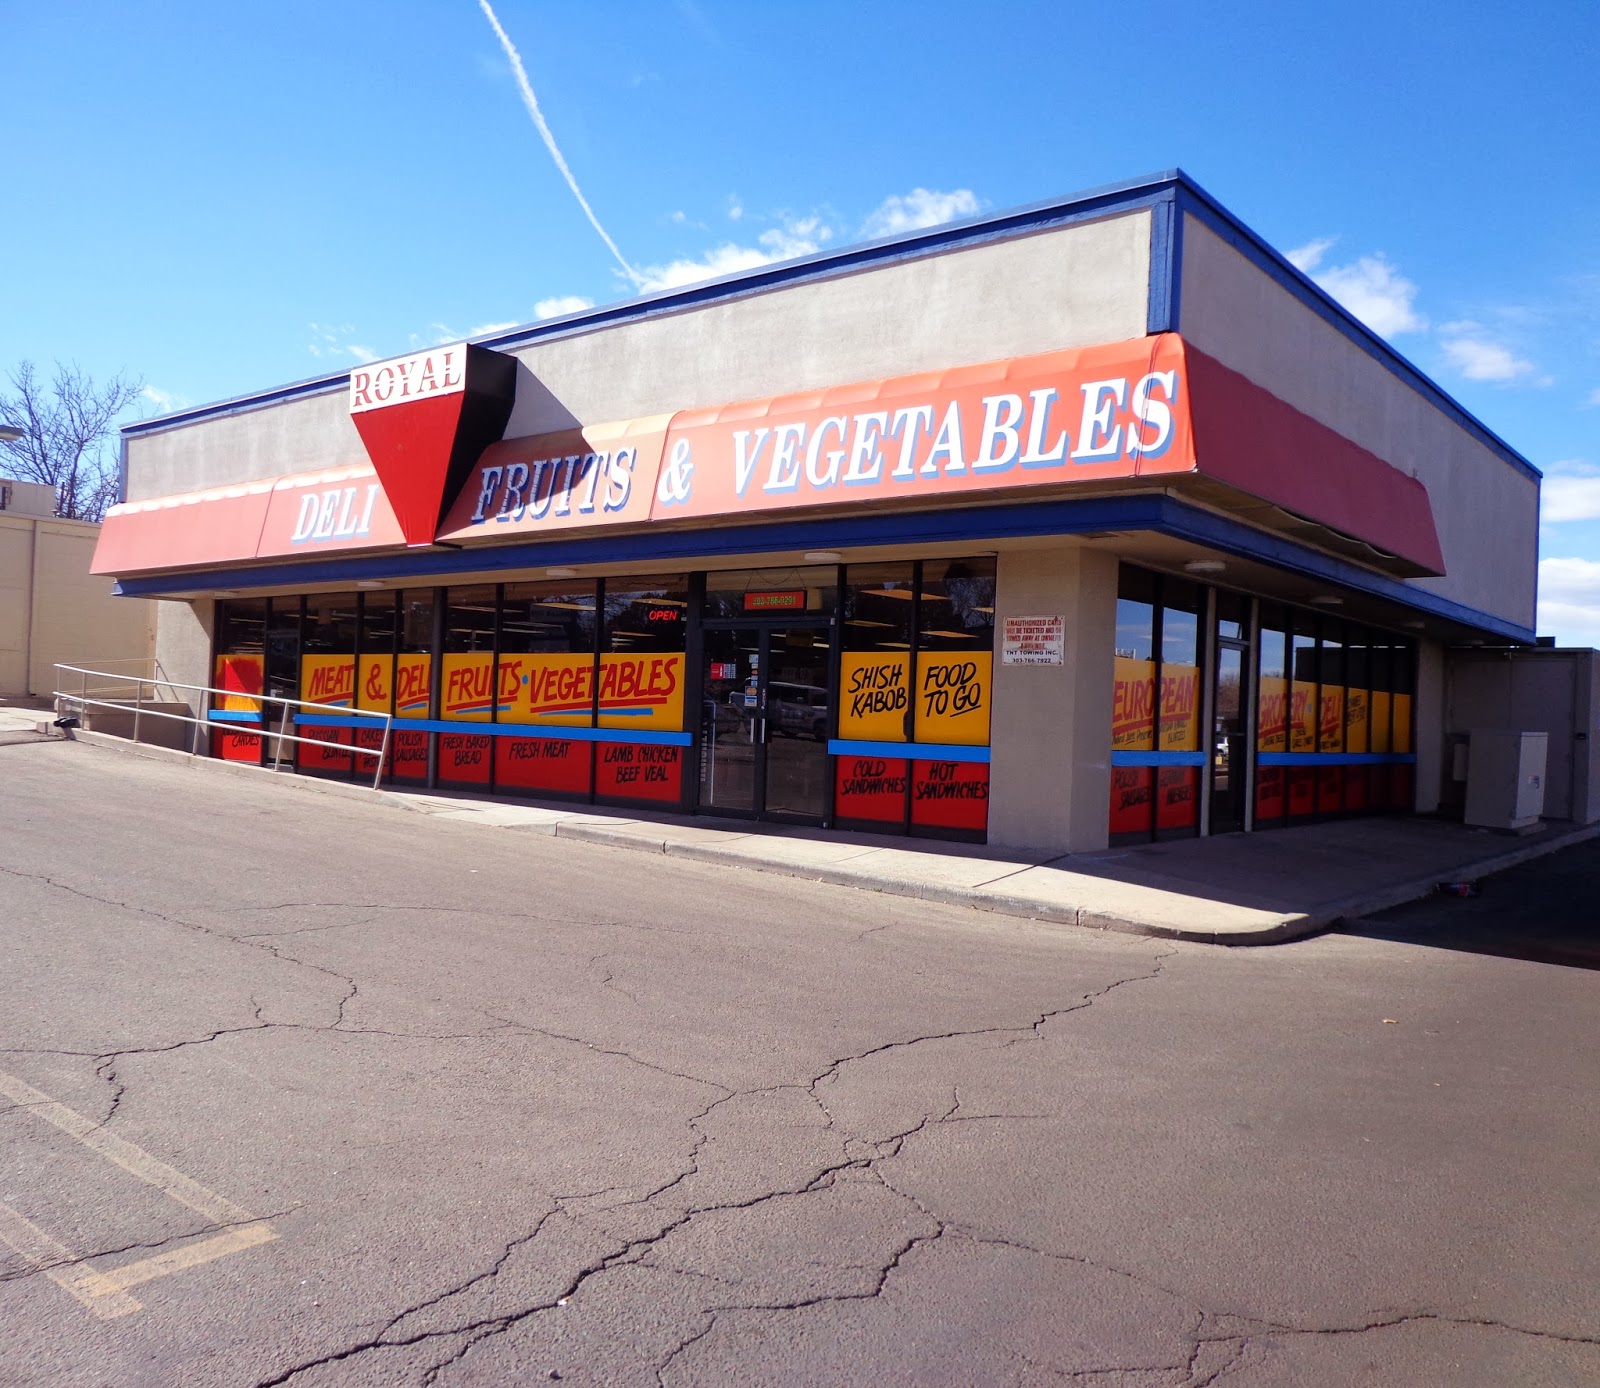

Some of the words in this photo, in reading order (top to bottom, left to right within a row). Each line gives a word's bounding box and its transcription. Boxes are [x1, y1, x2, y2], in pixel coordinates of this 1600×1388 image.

[353, 352, 461, 407] ROYAL
[470, 447, 638, 524] FRUITS
[658, 438, 694, 507] &
[732, 369, 1180, 496] VEGETABLES
[291, 483, 380, 545] DELI
[649, 610, 677, 621] OPEN
[308, 664, 354, 698] MEAT
[366, 663, 387, 700] &
[396, 664, 431, 701] DELI
[446, 660, 522, 703] FRUITS
[530, 657, 678, 704] VEGETABLES
[848, 664, 902, 693] SHISH
[924, 662, 977, 690] FOOD
[850, 687, 907, 718] KABOB
[924, 690, 949, 718] TO
[952, 683, 981, 711] GO
[1112, 675, 1198, 723] EUROPEAN
[397, 733, 423, 747] POLISH
[443, 737, 464, 750] FRESH
[466, 736, 490, 749] BAKED
[455, 750, 482, 767] BREAD
[509, 742, 540, 760] FRESH
[541, 742, 571, 759] MEAT
[604, 745, 633, 763] LAMB
[638, 746, 678, 763] CHICKEN
[616, 766, 640, 783] BEEF
[645, 766, 669, 782] VEAL
[853, 760, 887, 778] COLD
[929, 762, 959, 782] HOT
[841, 778, 906, 796] SANDWICHES
[916, 781, 989, 800] SANDWICHES
